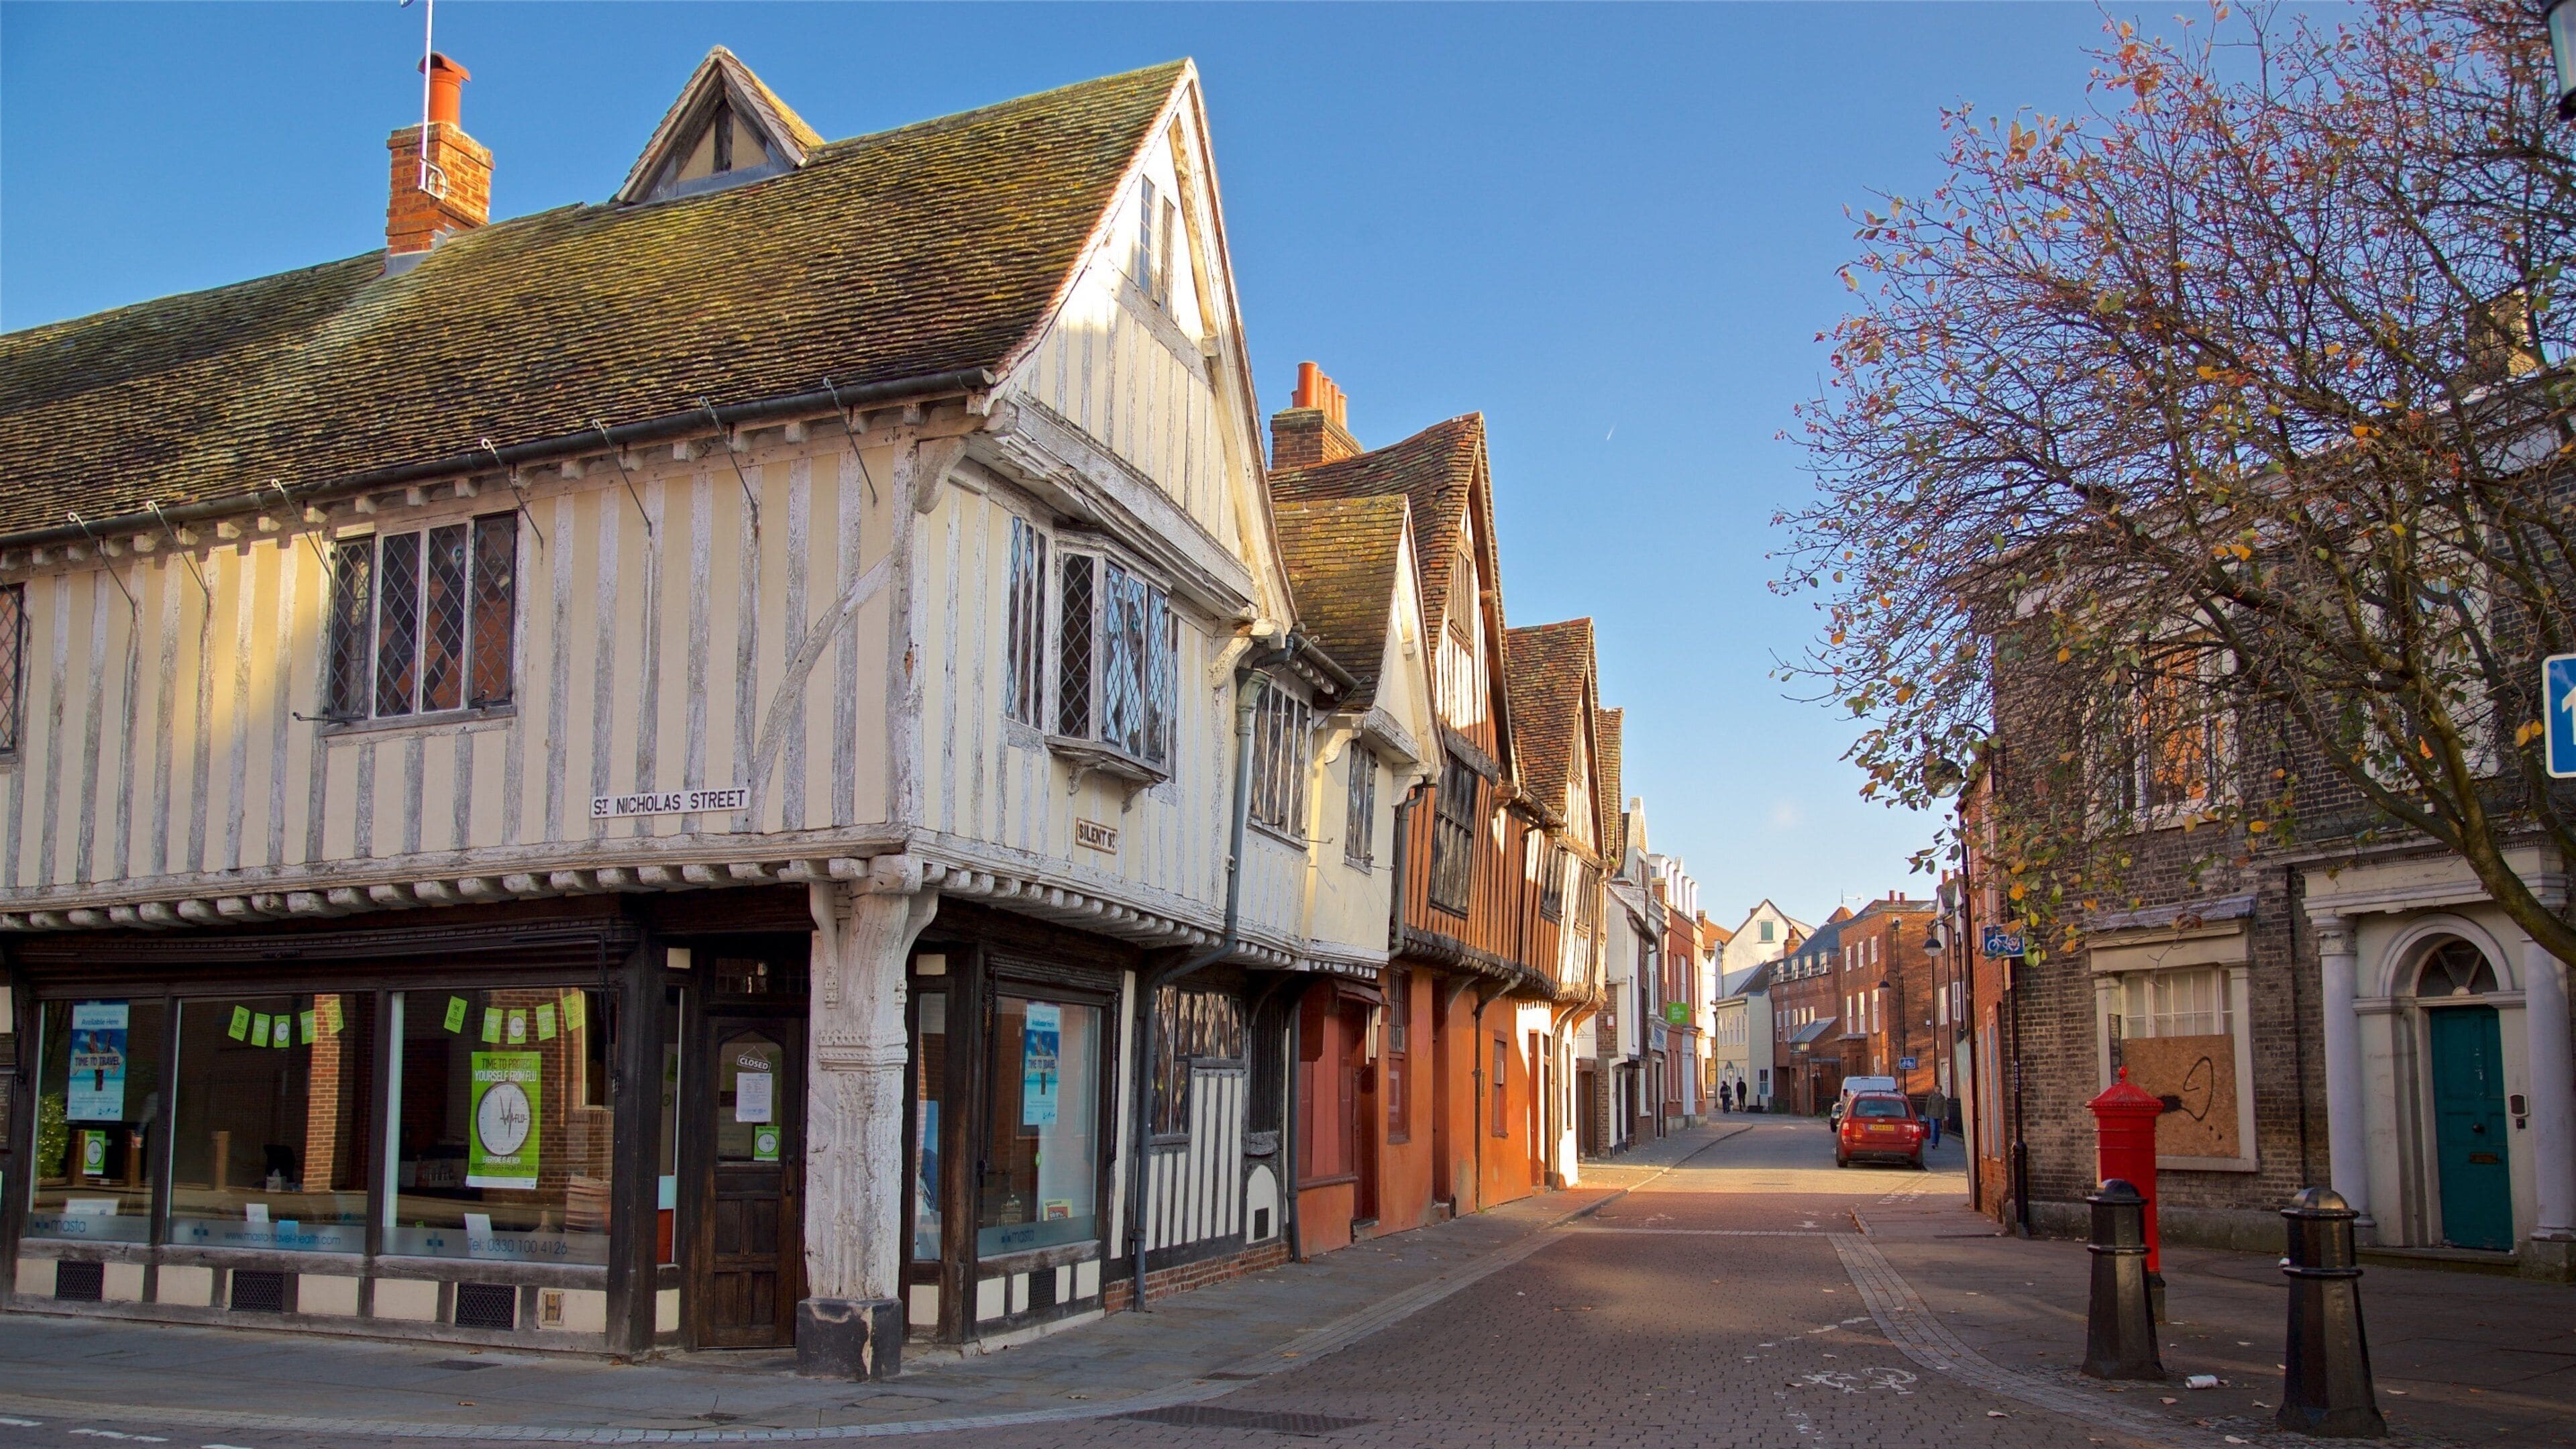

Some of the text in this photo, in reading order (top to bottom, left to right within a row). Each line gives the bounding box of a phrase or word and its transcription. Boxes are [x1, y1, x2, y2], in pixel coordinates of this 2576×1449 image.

[616, 794, 681, 814] NICHOLAS
[690, 790, 745, 809] STREET
[1079, 823, 1106, 846] SILENT
[75, 1057, 120, 1066] TIME TO TRAVEL
[482, 1058, 533, 1069] TIME TO PROTECT
[739, 1057, 769, 1070] CLOSED
[475, 1070, 537, 1082] YOURSELF FROM FLU
[515, 1114, 525, 1123] FLU
[50, 1220, 87, 1233] masta
[225, 1232, 340, 1246] www.masta-travel-health.com
[1012, 1230, 1034, 1244] masta
[469, 1238, 568, 1255] Tel: 0330 100 4126
